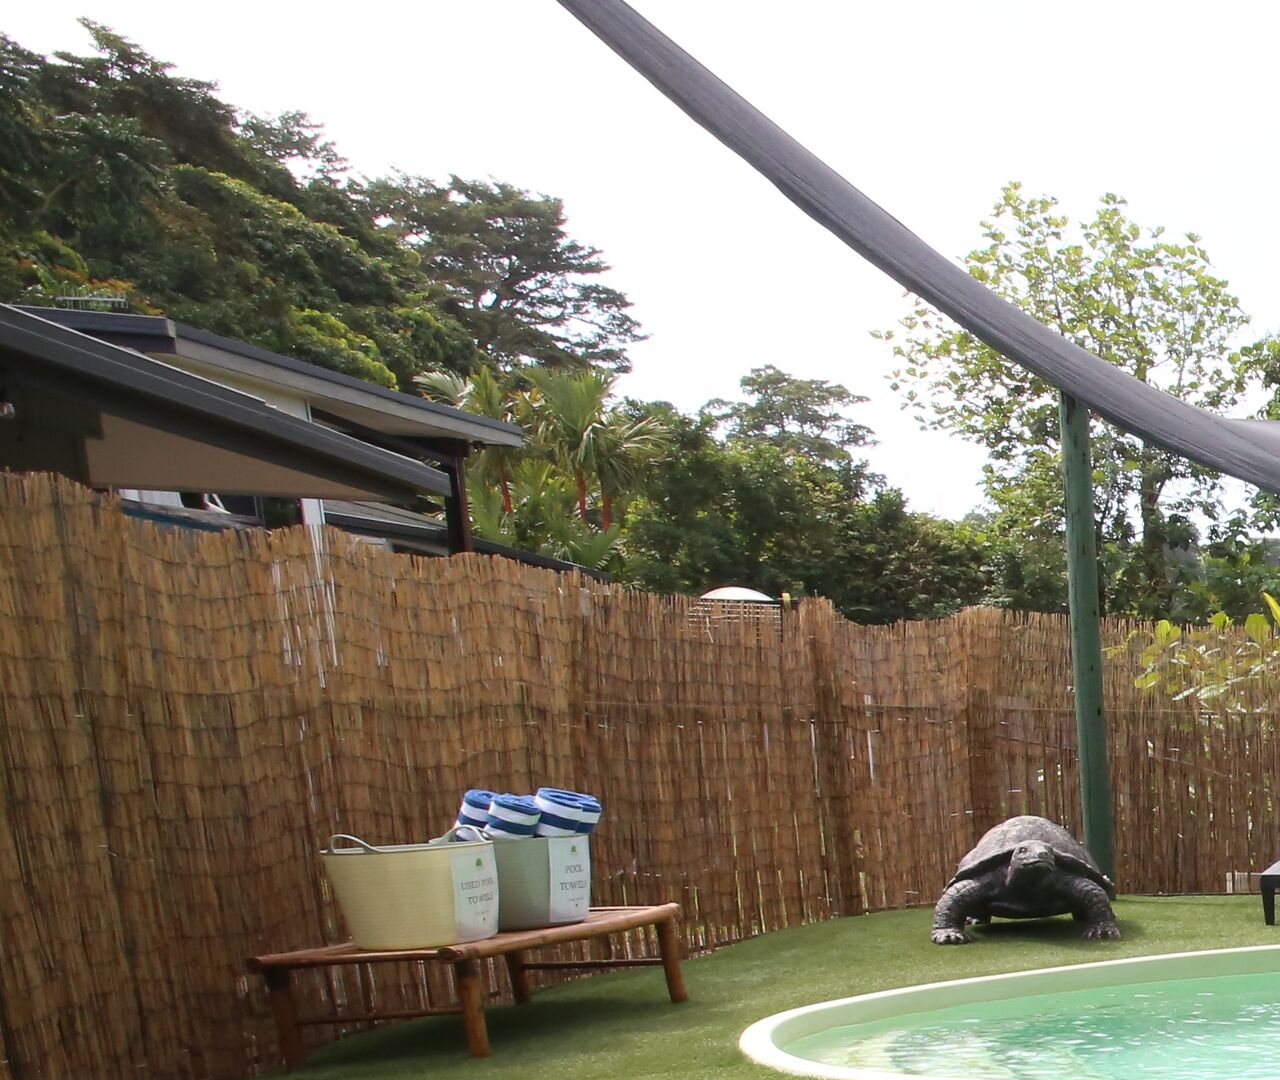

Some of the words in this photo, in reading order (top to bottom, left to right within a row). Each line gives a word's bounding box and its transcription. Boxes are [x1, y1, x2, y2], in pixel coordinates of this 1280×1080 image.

[565, 864, 583, 874] POOL
[461, 879, 481, 890] USED
[560, 880, 587, 891] TOWELS
